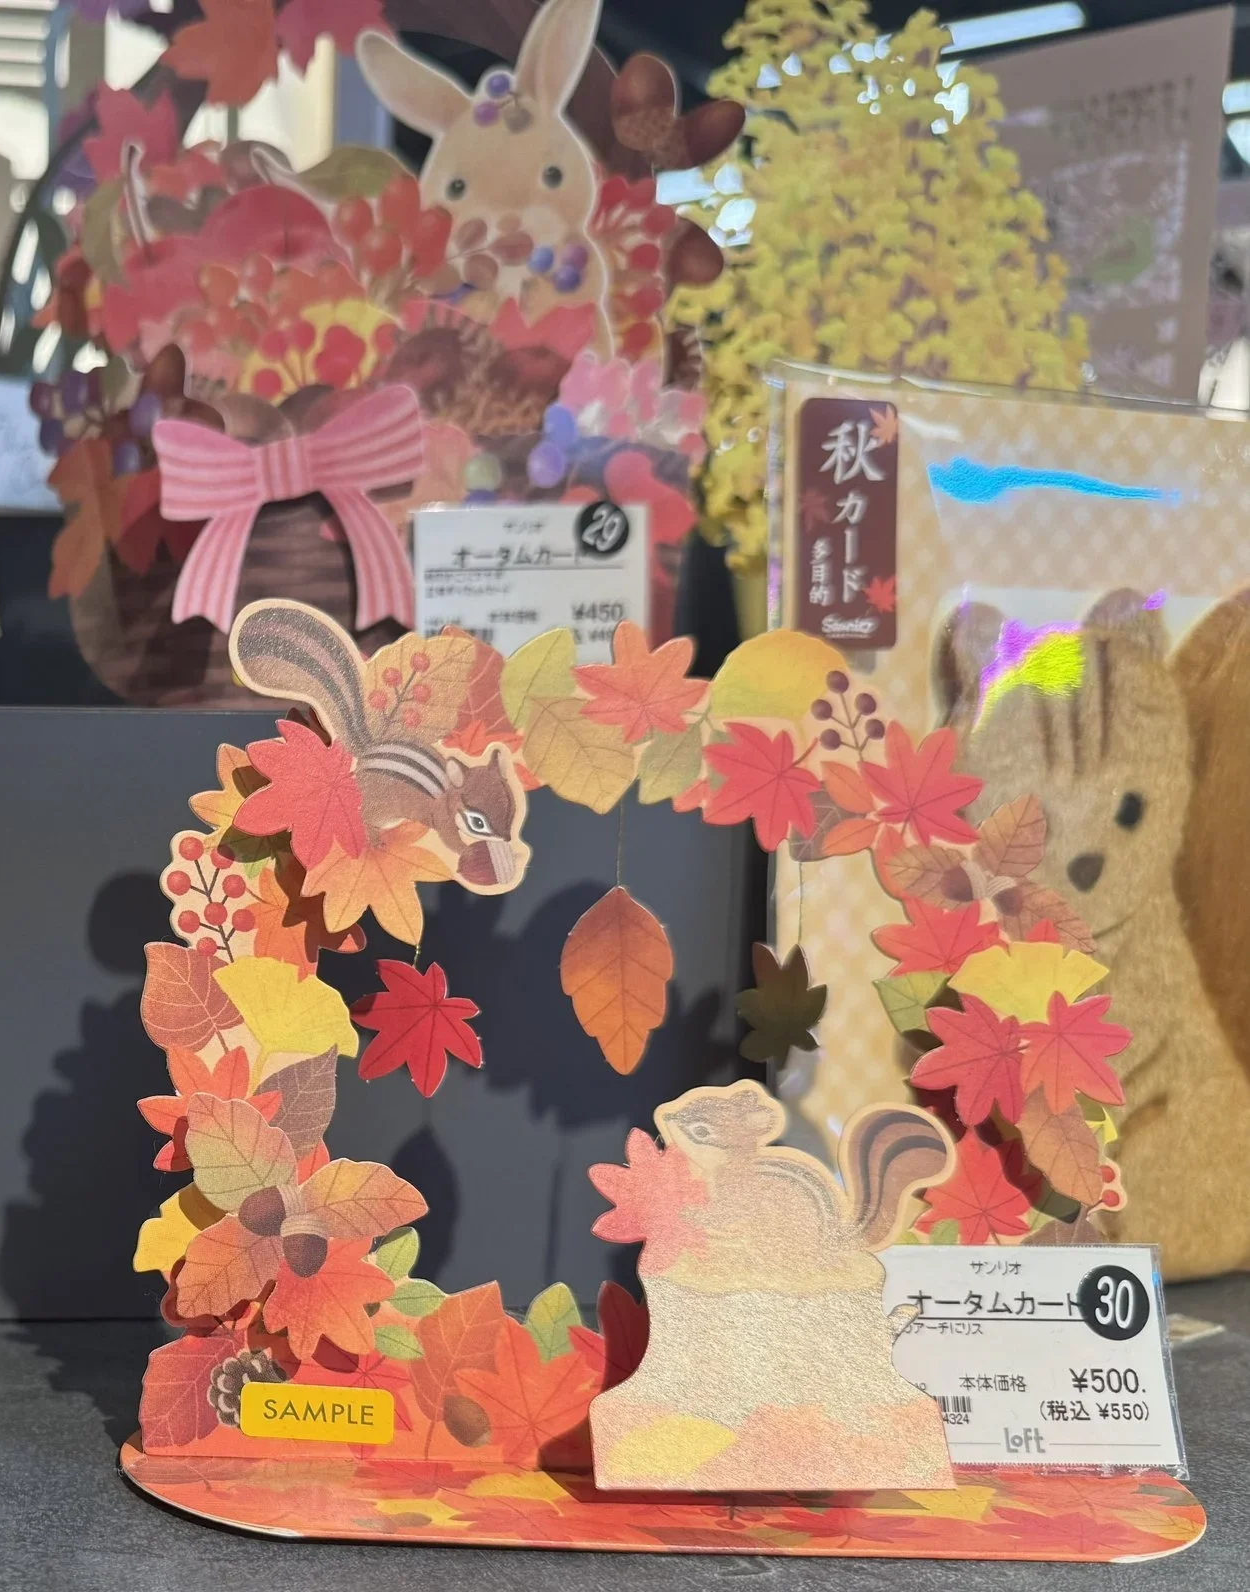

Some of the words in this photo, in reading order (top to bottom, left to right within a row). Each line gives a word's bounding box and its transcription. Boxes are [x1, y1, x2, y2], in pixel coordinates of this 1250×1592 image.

[582, 505, 628, 552] 29
[819, 420, 886, 604] 秋カード
[809, 537, 833, 606] 多目的
[970, 1260, 1022, 1276] サンリオ
[1095, 1275, 1134, 1329] 30
[958, 1373, 1028, 1392] 本体価格
[1069, 1368, 1147, 1394] ¥500.
[263, 1399, 374, 1426] SAMPLE
[1039, 1400, 1091, 1422] (税込
[1097, 1401, 1150, 1422] ¥550)
